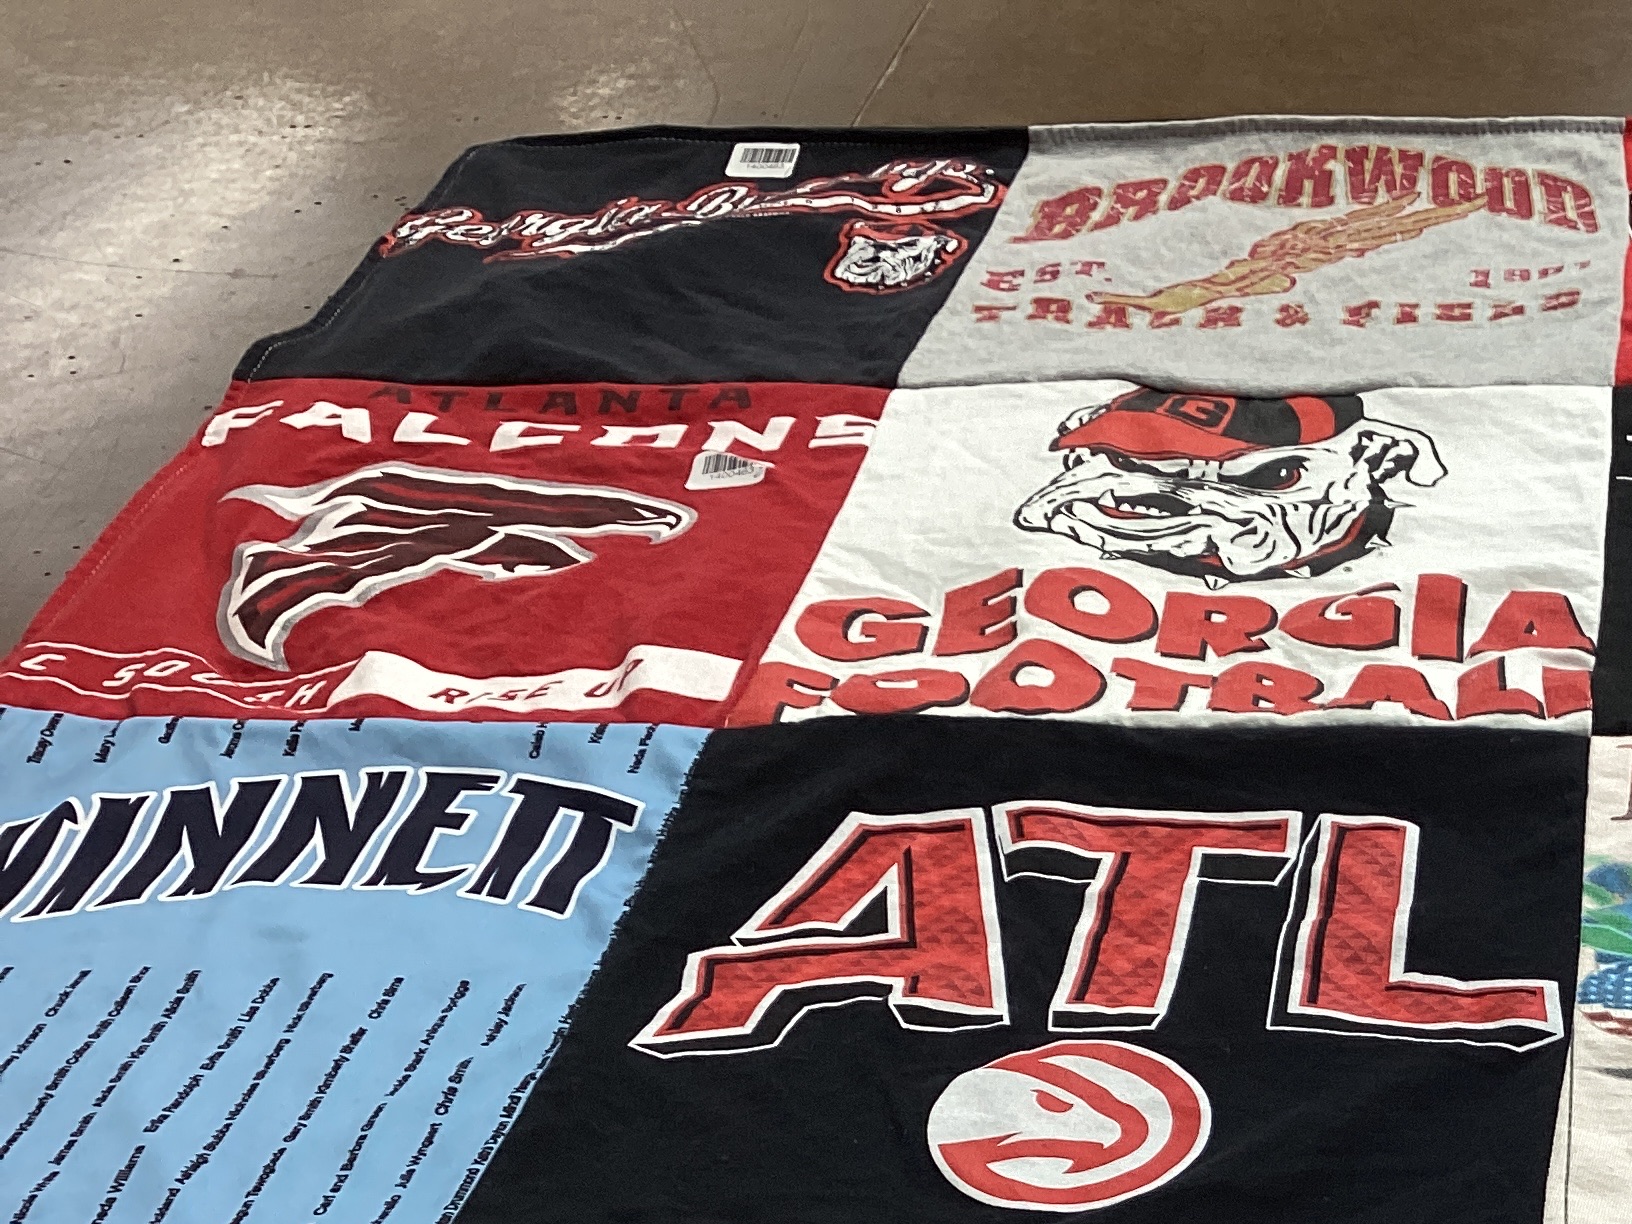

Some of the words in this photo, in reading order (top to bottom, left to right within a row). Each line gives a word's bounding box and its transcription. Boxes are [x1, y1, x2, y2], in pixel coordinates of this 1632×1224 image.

[1009, 144, 1598, 244] BROOKWOOD
[202, 401, 879, 452] FALCONS
[369, 385, 752, 414] ATLANTA
[794, 565, 1598, 664] GEORGIA
[722, 638, 1593, 728] FOOTBALL
[630, 799, 1563, 1058] ATL
